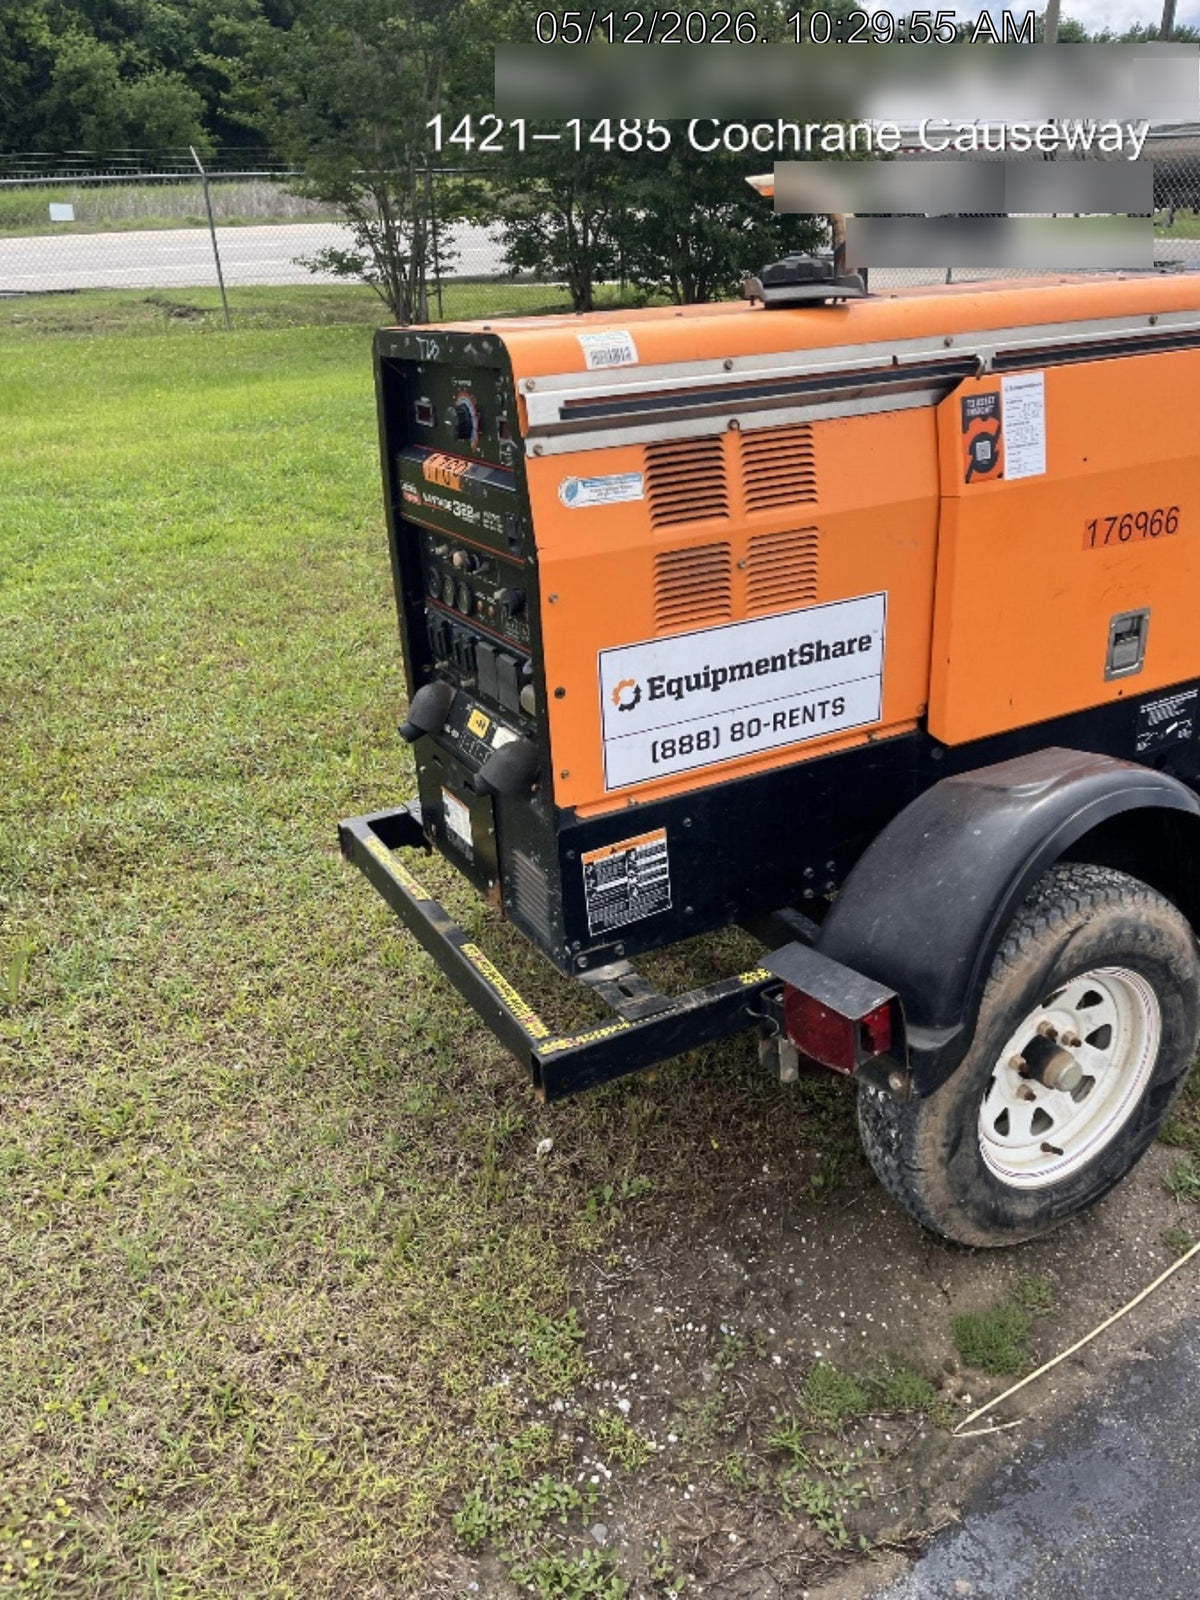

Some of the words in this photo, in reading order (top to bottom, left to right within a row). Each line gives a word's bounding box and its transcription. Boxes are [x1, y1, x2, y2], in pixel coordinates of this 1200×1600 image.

[1087, 506, 1180, 547] 176966
[647, 632, 873, 701] EquipmentShare
[651, 726, 720, 764] (888)
[730, 697, 846, 743] 80-RENTS
